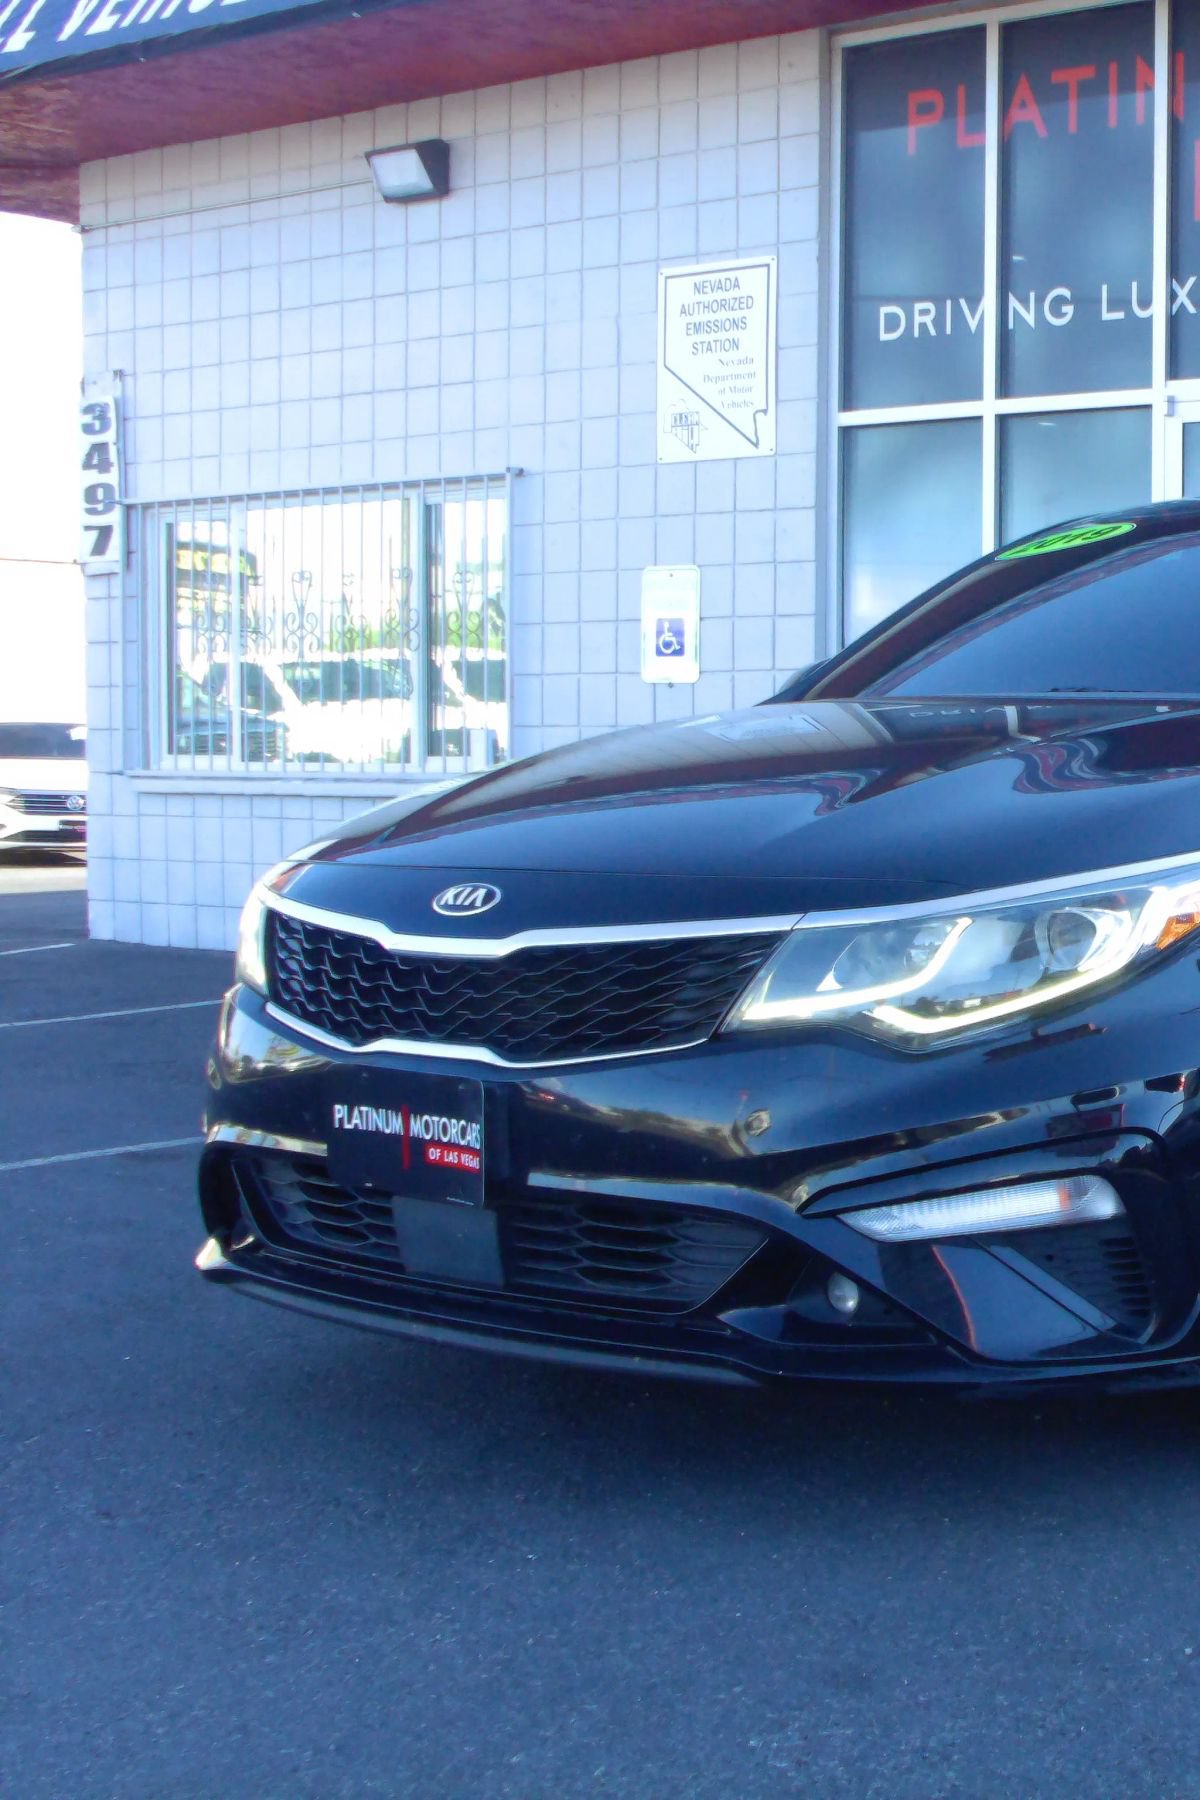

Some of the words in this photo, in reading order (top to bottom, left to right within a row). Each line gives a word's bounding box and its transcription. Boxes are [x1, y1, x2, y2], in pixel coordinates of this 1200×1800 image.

[693, 276, 741, 297] NEVADA
[680, 295, 754, 318] AUTHORIZED
[880, 286, 1075, 342] DRIVNG
[685, 316, 748, 337] EMISSIONS
[691, 337, 740, 356] STATION
[81, 402, 118, 557] 3497
[439, 886, 488, 907] KIA
[333, 1103, 404, 1136] PLATINUM
[409, 1112, 481, 1150] MOTORCARS
[428, 1147, 441, 1161] OF
[444, 1149, 459, 1164] LAS
[461, 1152, 480, 1170] VEGAS
